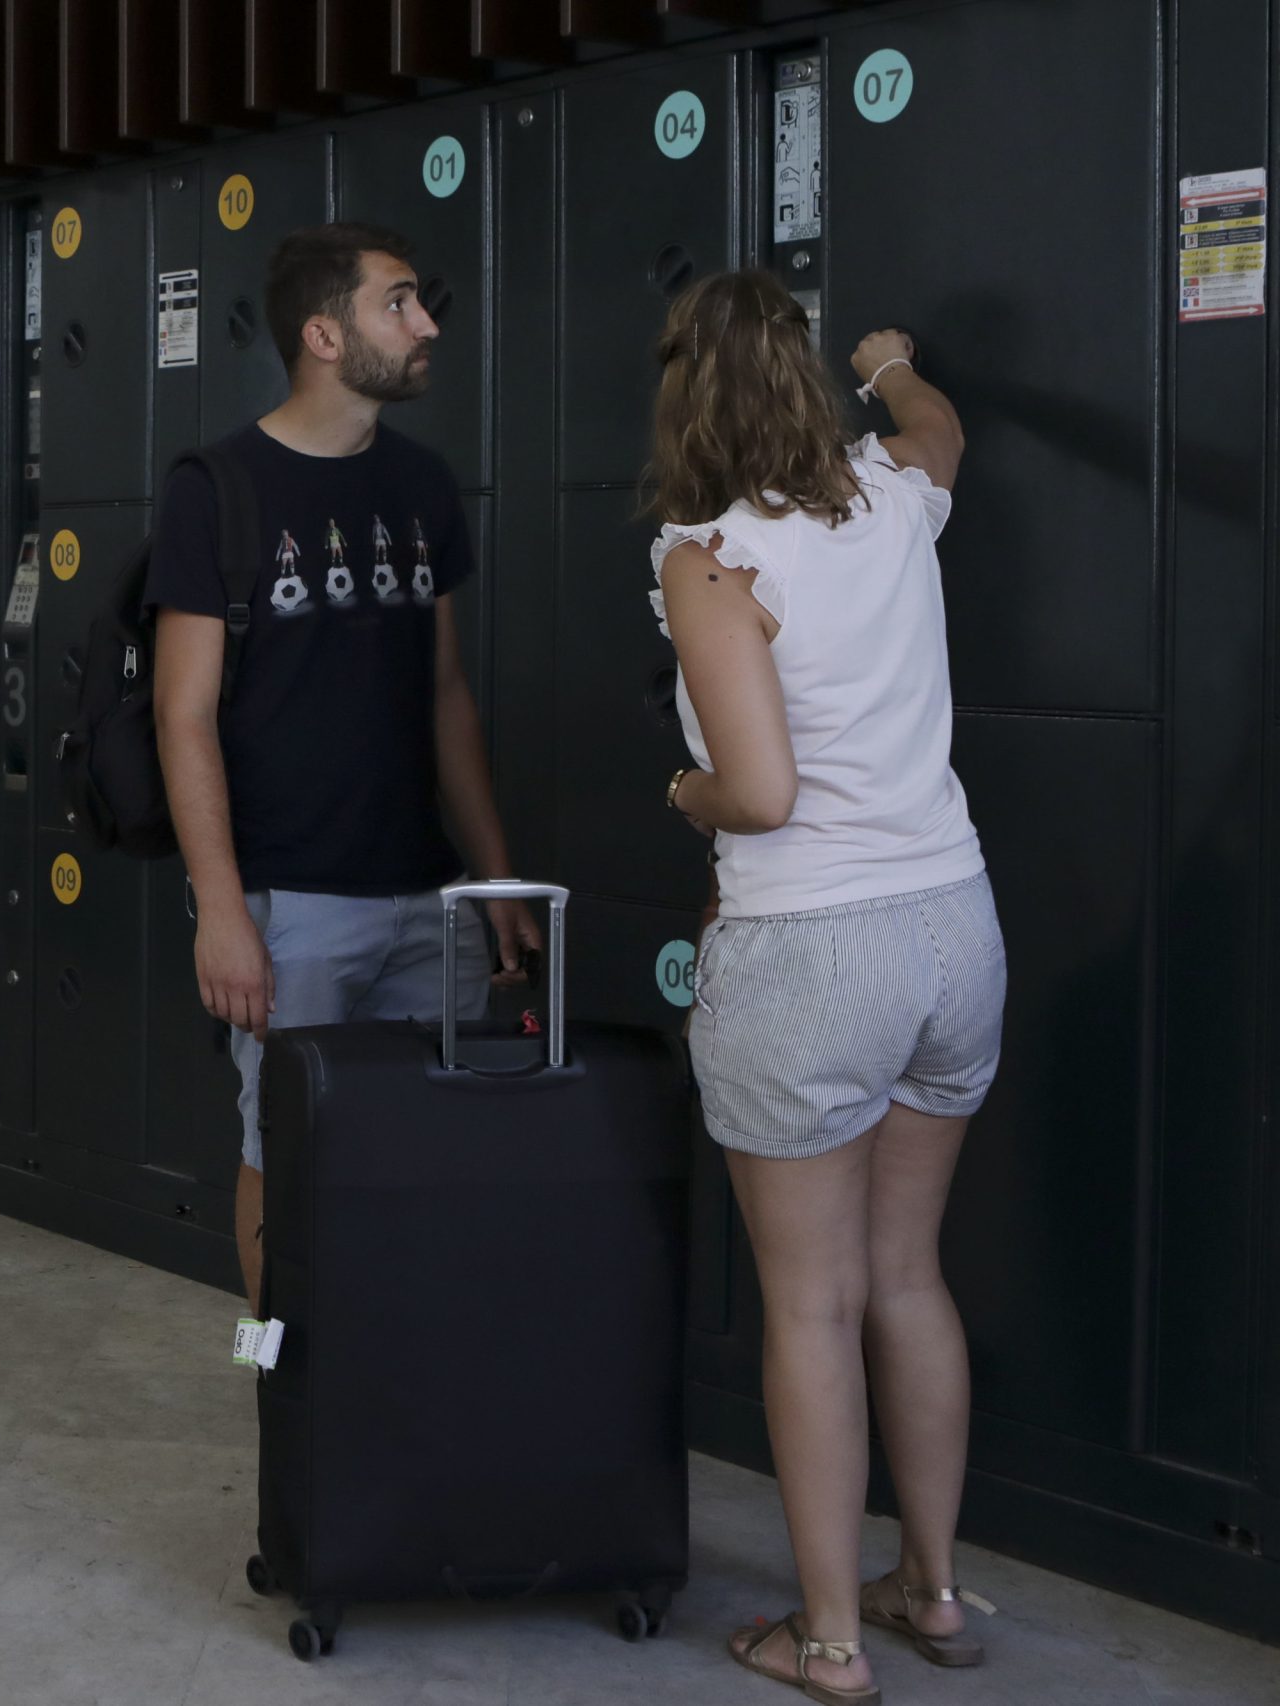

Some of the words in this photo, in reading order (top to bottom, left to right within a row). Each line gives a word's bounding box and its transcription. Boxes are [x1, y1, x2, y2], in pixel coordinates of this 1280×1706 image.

[863, 68, 904, 105] 07
[663, 108, 697, 143] 04
[430, 151, 455, 182] 01
[223, 188, 248, 215] 10
[56, 220, 77, 245] 07
[55, 543, 75, 567] 08
[3, 667, 26, 727] 3
[56, 866, 76, 891] 09
[664, 958, 694, 991] 06
